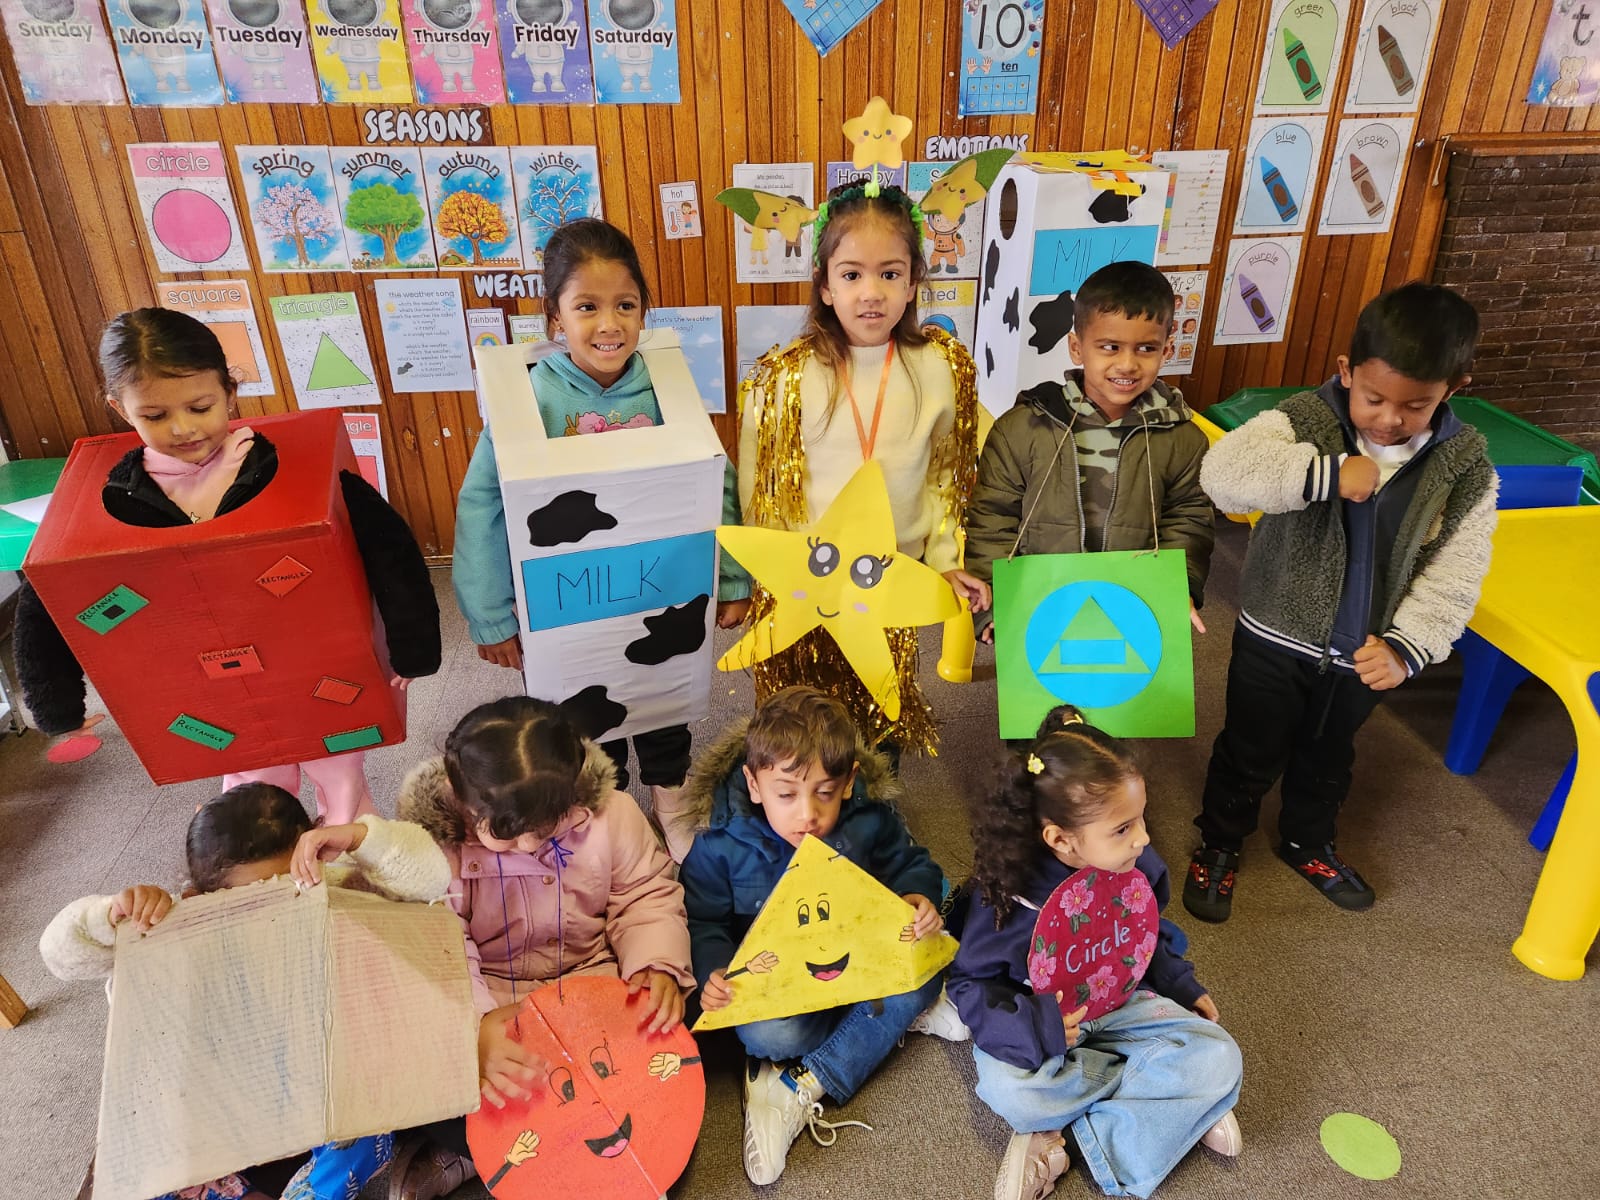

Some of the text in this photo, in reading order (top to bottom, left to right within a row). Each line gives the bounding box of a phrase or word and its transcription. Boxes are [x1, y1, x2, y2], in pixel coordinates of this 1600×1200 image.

[1294, 3, 1324, 18] green
[1391, 1, 1418, 14] black
[19, 22, 93, 41] Sunday
[315, 25, 398, 40] Wednesday
[516, 25, 578, 46] Friday
[978, 3, 1025, 49] 10
[121, 29, 202, 48] Monday
[216, 27, 303, 47] Tuesday
[413, 29, 491, 45] Thursday
[594, 29, 673, 46] Saturday
[1001, 61, 1018, 71] ten
[364, 109, 482, 143] SEASONS
[1276, 131, 1296, 142] blue
[1357, 134, 1389, 147] brown
[146, 151, 210, 173] circle
[252, 148, 315, 178] spring
[342, 151, 411, 178] summer
[438, 151, 500, 178] autumn
[529, 151, 582, 173] winter
[671, 189, 683, 199] hot
[1248, 251, 1279, 265] purple
[167, 286, 241, 307] square
[278, 294, 349, 315] triangle
[470, 314, 499, 324] rainbow
[260, 571, 309, 585] RECTANGLE
[557, 556, 661, 610] MILK
[79, 592, 118, 622] RECTANGLE
[202, 650, 248, 662] RECTANGLE
[176, 719, 224, 743] RECTANGLE
[1066, 920, 1130, 973] Circle
